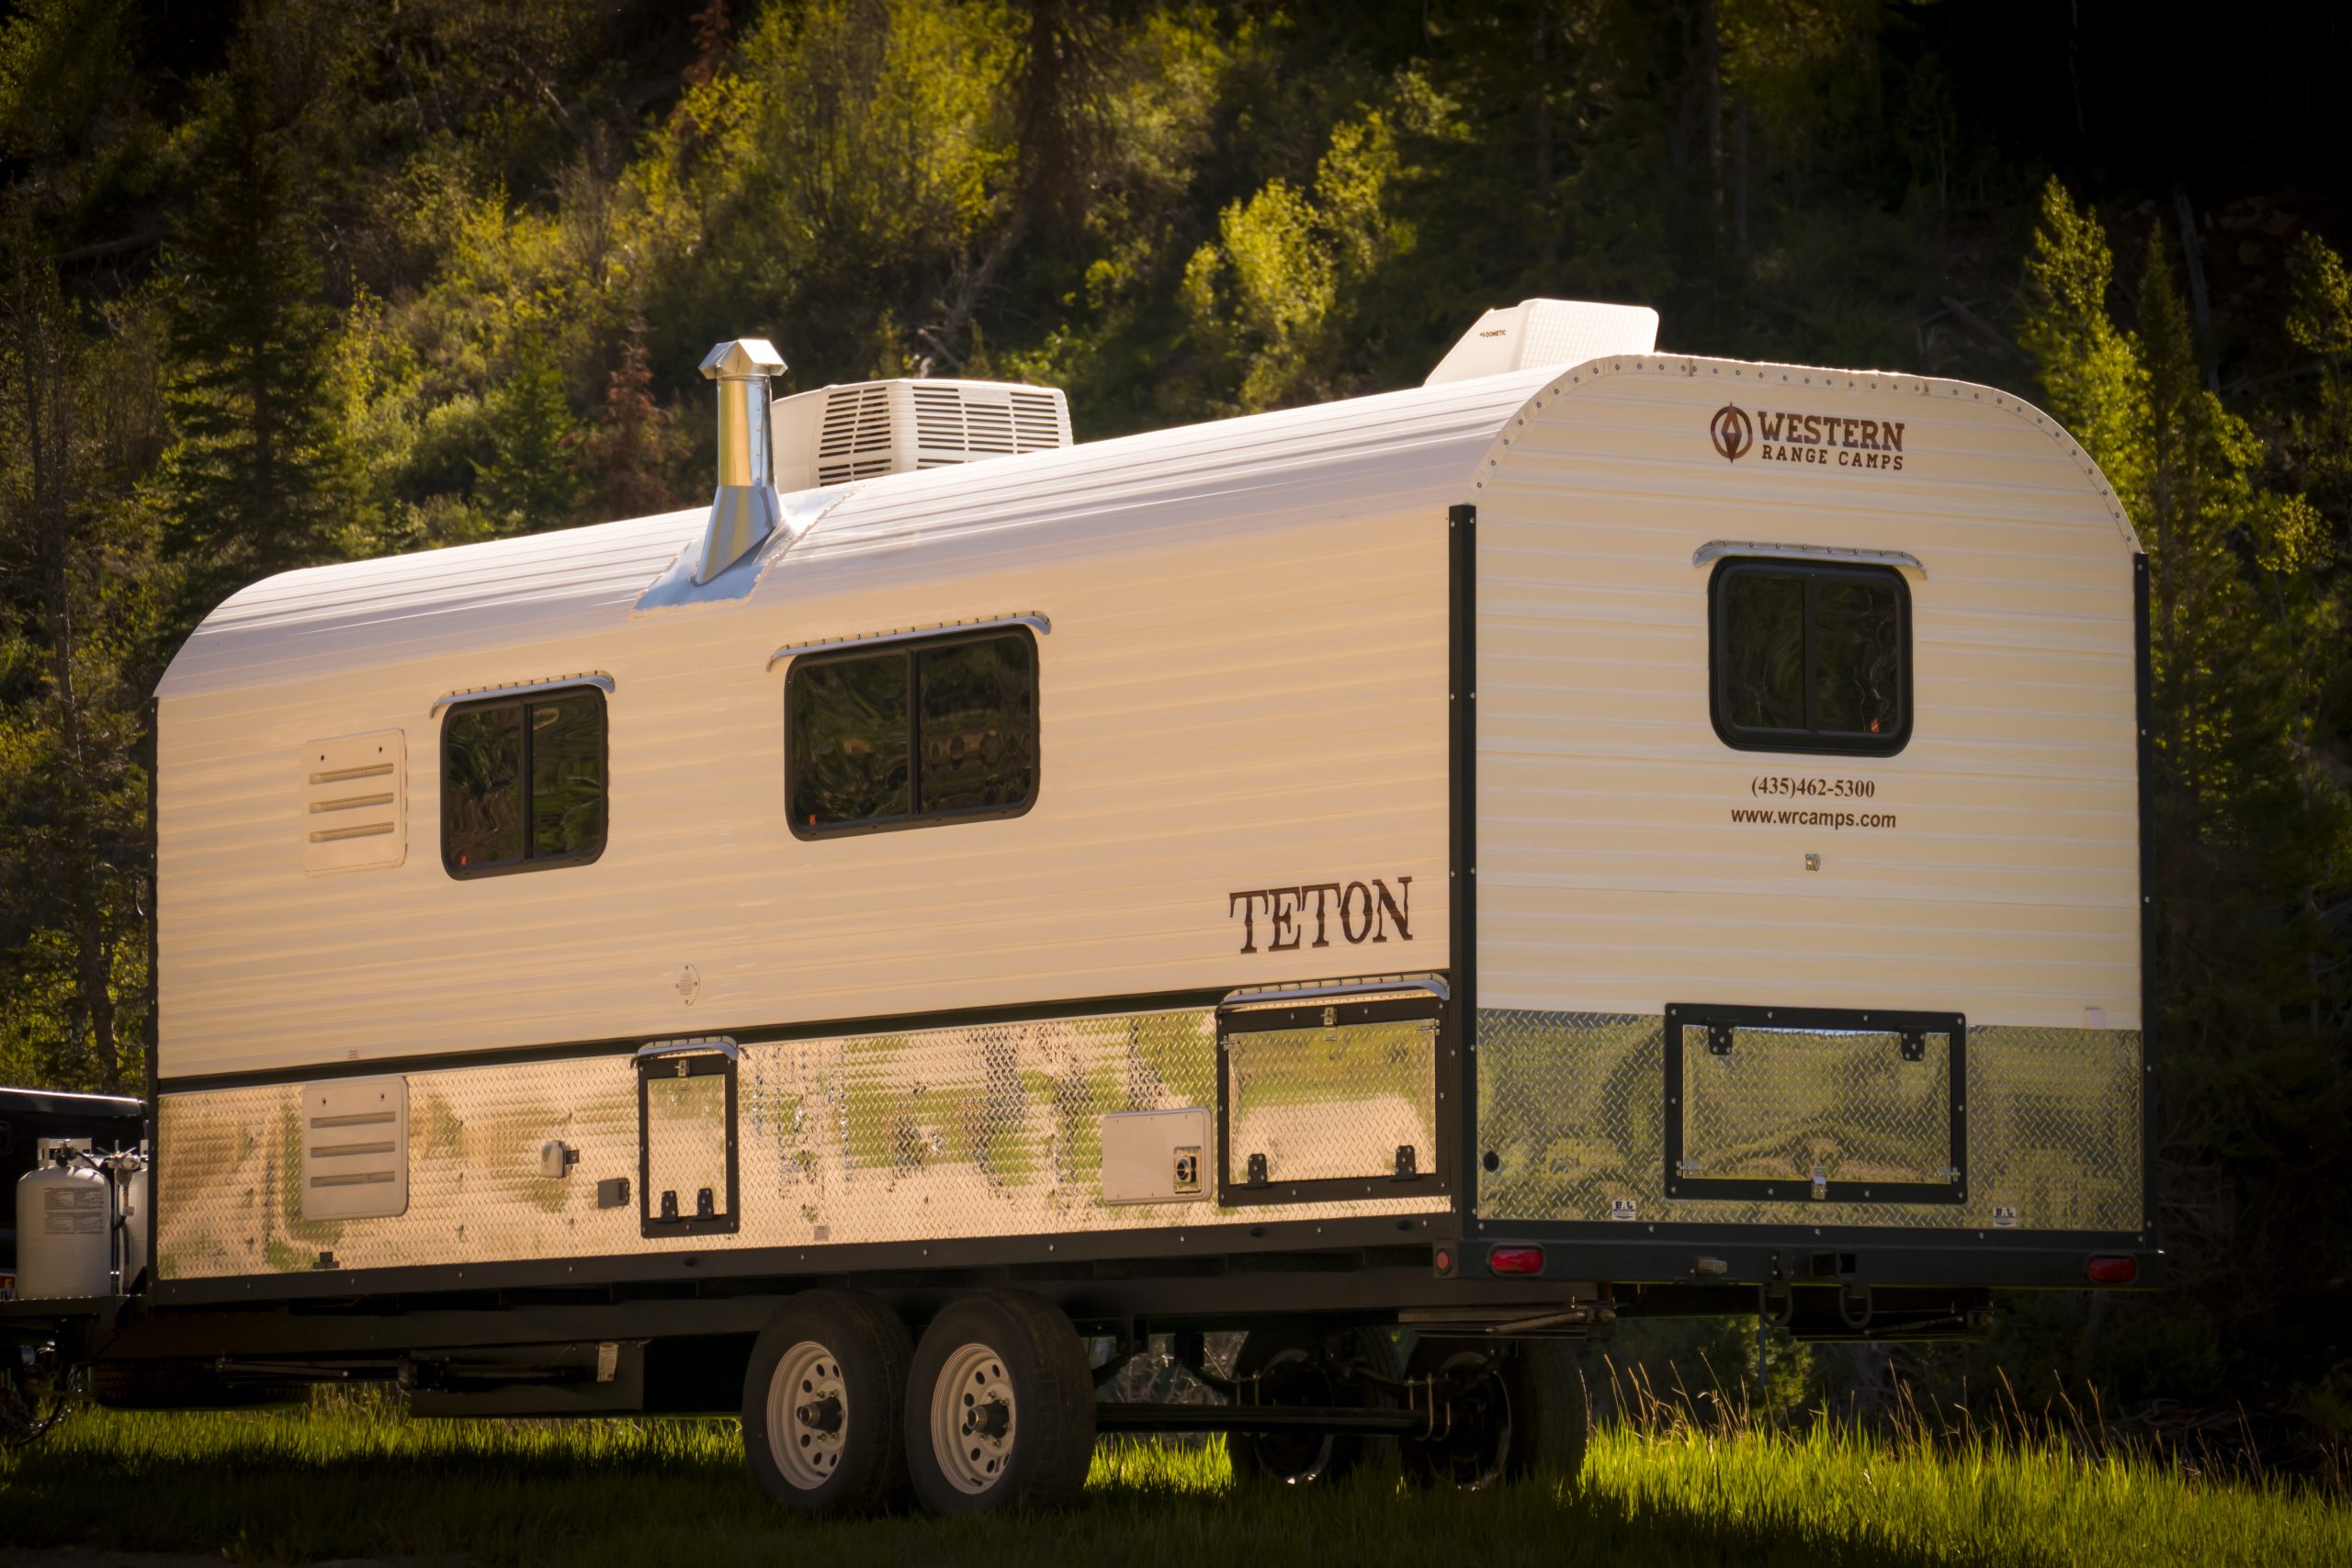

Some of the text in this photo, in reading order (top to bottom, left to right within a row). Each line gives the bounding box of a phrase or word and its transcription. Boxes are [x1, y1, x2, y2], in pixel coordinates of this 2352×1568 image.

[1757, 411, 1905, 452] WESTERN
[1762, 445, 1904, 471] RANGE CAMPS
[1751, 776, 1875, 799] (435)462-5300
[1731, 809, 1896, 830] www.wrcamps.com
[1229, 876, 1413, 954] TETON
